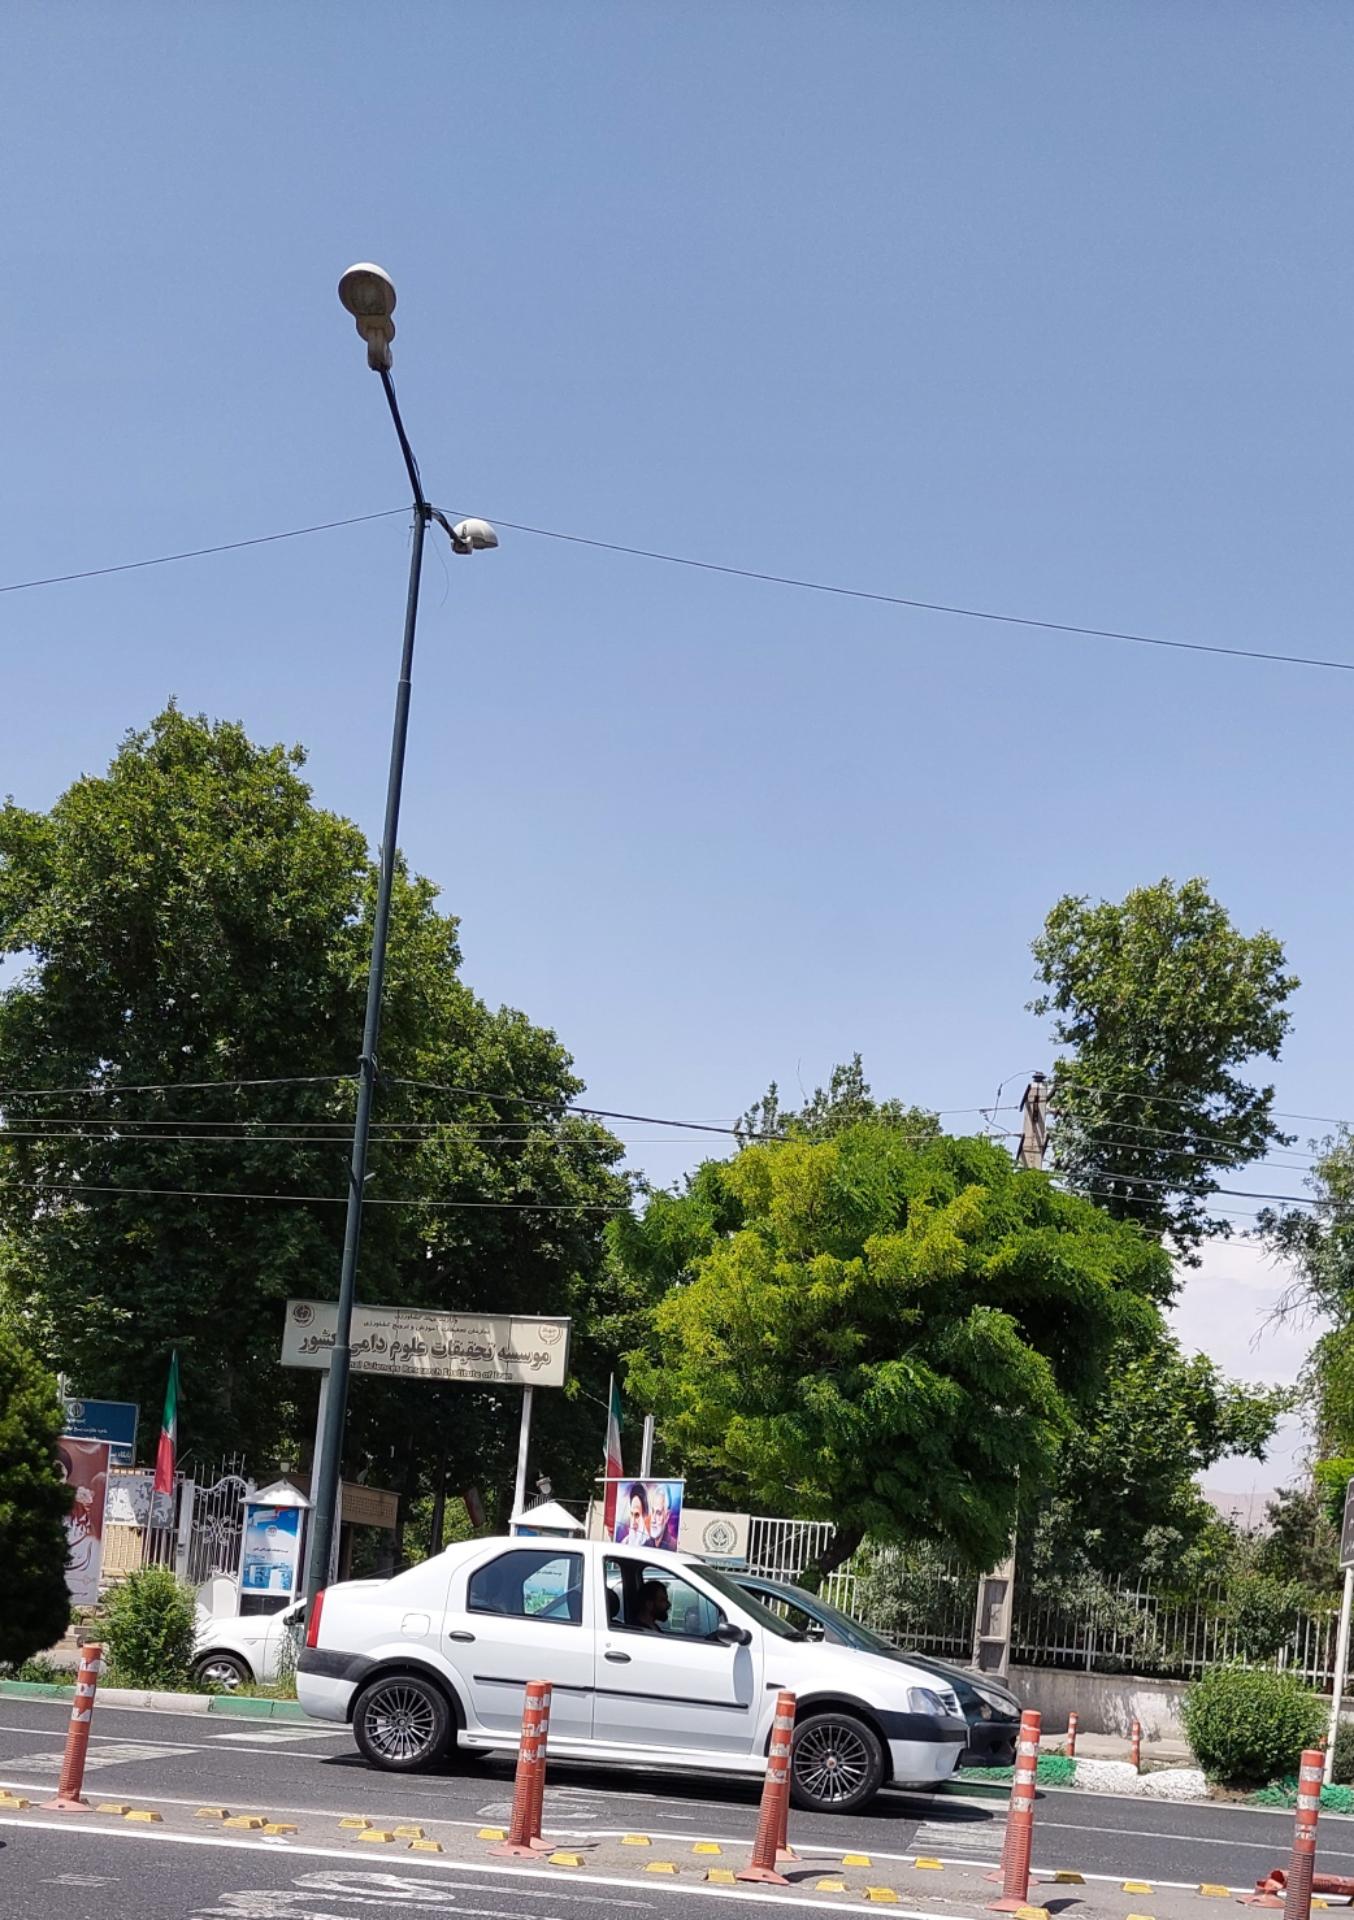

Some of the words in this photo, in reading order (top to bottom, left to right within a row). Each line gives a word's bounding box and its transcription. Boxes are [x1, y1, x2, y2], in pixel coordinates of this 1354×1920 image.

[350, 1333, 388, 1357] دامی
[390, 1336, 428, 1362] علوم
[431, 1339, 496, 1365] تحقیقات
[497, 1345, 551, 1371] موسسه
